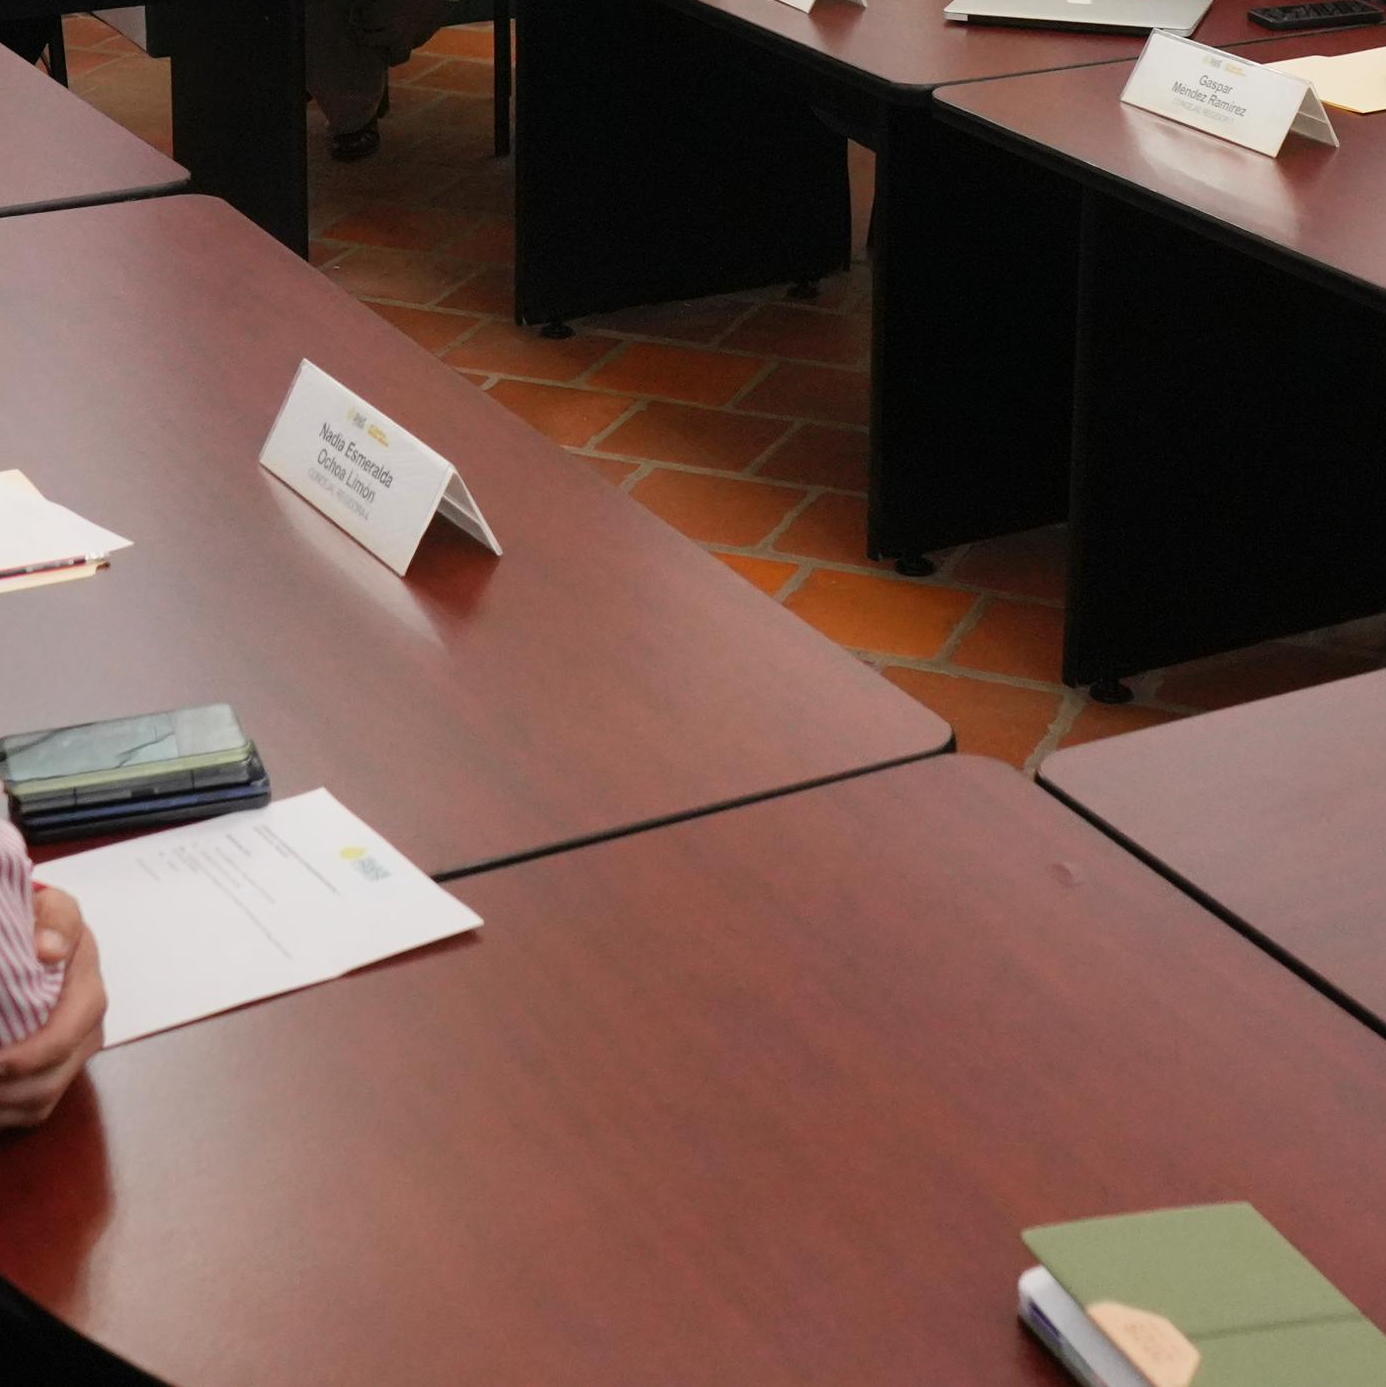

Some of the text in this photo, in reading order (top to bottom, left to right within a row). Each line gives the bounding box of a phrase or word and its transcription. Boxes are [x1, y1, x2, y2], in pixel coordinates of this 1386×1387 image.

[1199, 74, 1233, 95] Gaspar
[317, 448, 346, 481] Ochoa
[345, 470, 376, 504] Limón
[318, 422, 344, 452] Nadia
[345, 442, 394, 489] Esmeralda
